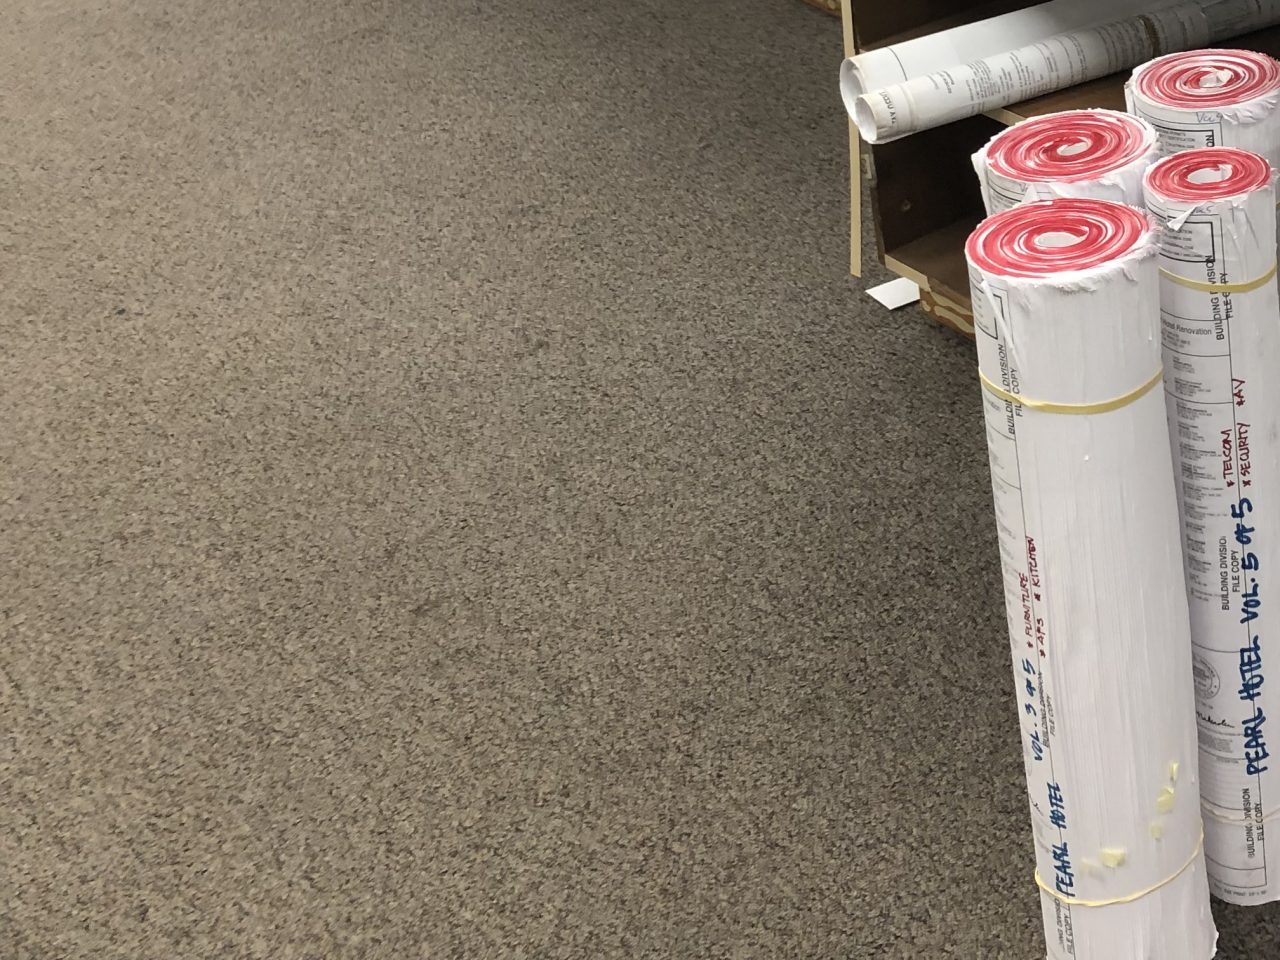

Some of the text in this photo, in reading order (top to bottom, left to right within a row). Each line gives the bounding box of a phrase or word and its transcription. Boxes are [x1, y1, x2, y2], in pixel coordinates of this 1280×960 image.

[1205, 255, 1224, 340] BUILDING DVISION
[1220, 273, 1233, 318] FILE CPY
[998, 343, 1015, 434] BUILDI DIVISION
[1010, 368, 1023, 417] FIL COPY
[1232, 378, 1251, 476] SECURITY AV
[1220, 429, 1233, 479] TELCOM
[1025, 536, 1041, 588] KITCHEN
[1219, 536, 1230, 610] BUILDING DIVISIO
[1230, 550, 1240, 592] FILE COPY
[1018, 572, 1032, 638] FURNITURE
[1230, 498, 1269, 776] PEARL HOTEL VOL. 5 OF 5
[1022, 658, 1036, 675] 5
[1024, 704, 1036, 716] 3
[1029, 723, 1043, 761] VOL.
[1047, 782, 1066, 829] HOTEL
[1256, 824, 1264, 841] FILE
[1052, 842, 1075, 897] PEARL
